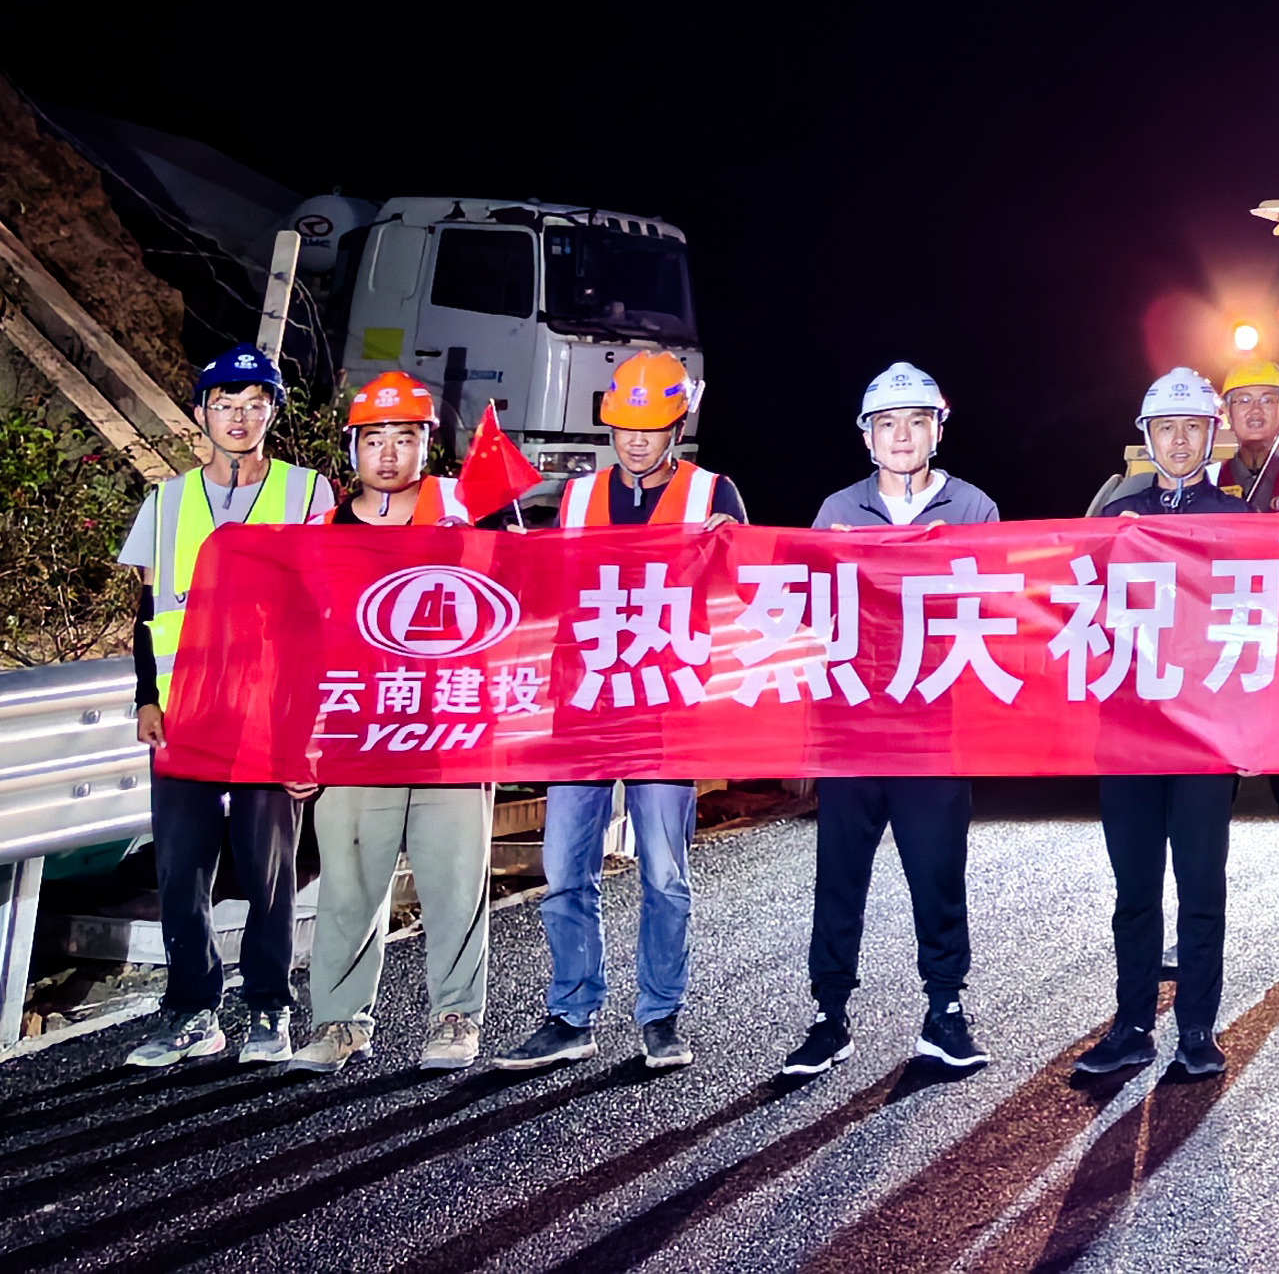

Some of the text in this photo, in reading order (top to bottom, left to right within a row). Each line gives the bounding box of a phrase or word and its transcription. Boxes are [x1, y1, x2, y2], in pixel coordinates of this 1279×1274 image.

[318, 667, 545, 714] 云南建投
[360, 723, 488, 752] YCIH
